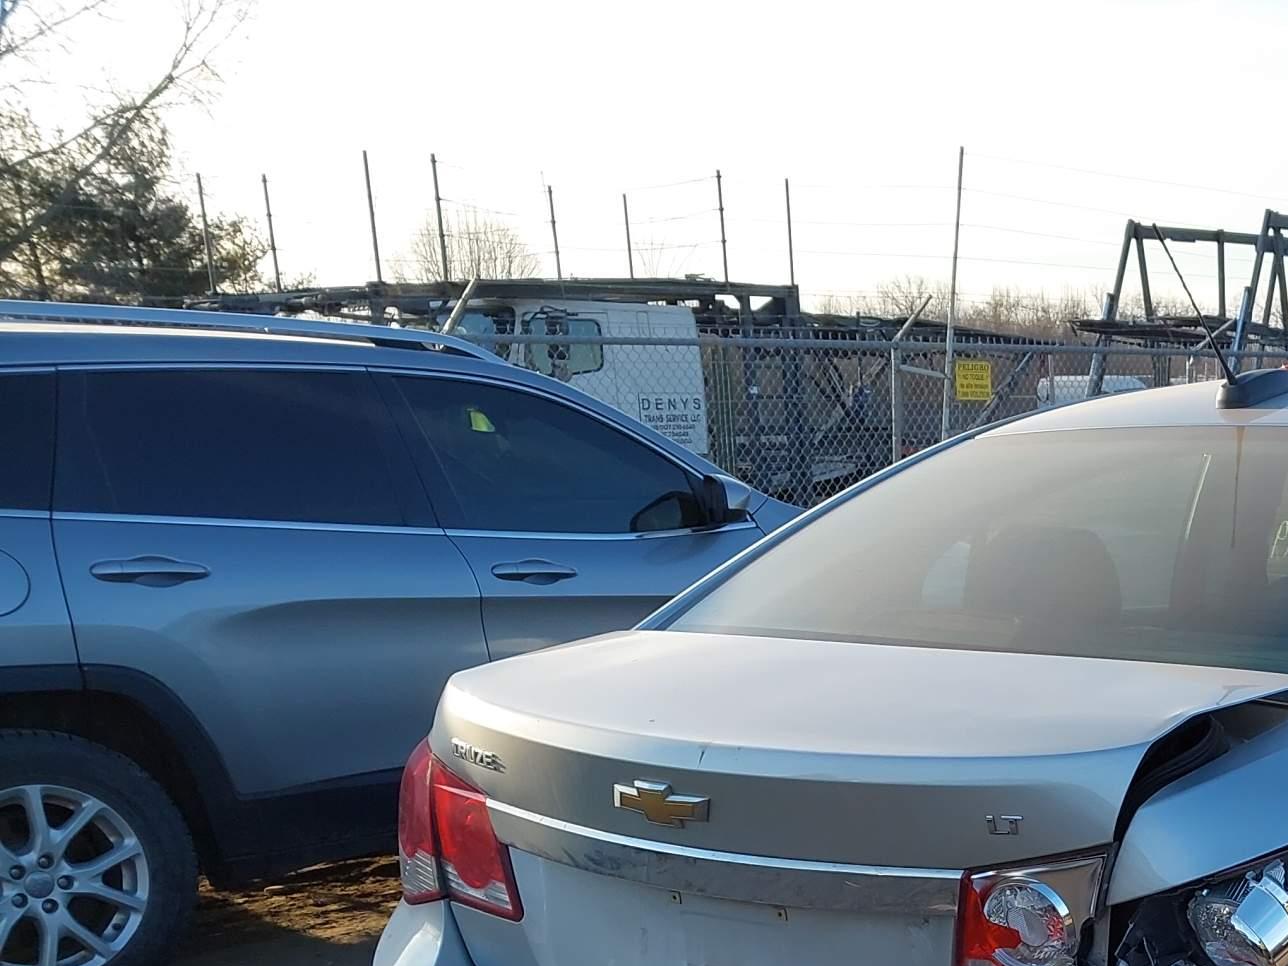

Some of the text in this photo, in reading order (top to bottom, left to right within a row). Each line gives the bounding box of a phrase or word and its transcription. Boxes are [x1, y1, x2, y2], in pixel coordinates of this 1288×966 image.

[641, 397, 702, 411] DENYS
[666, 414, 689, 422] SERVICE
[451, 737, 497, 770] CRUZE
[985, 815, 1024, 836] LT
